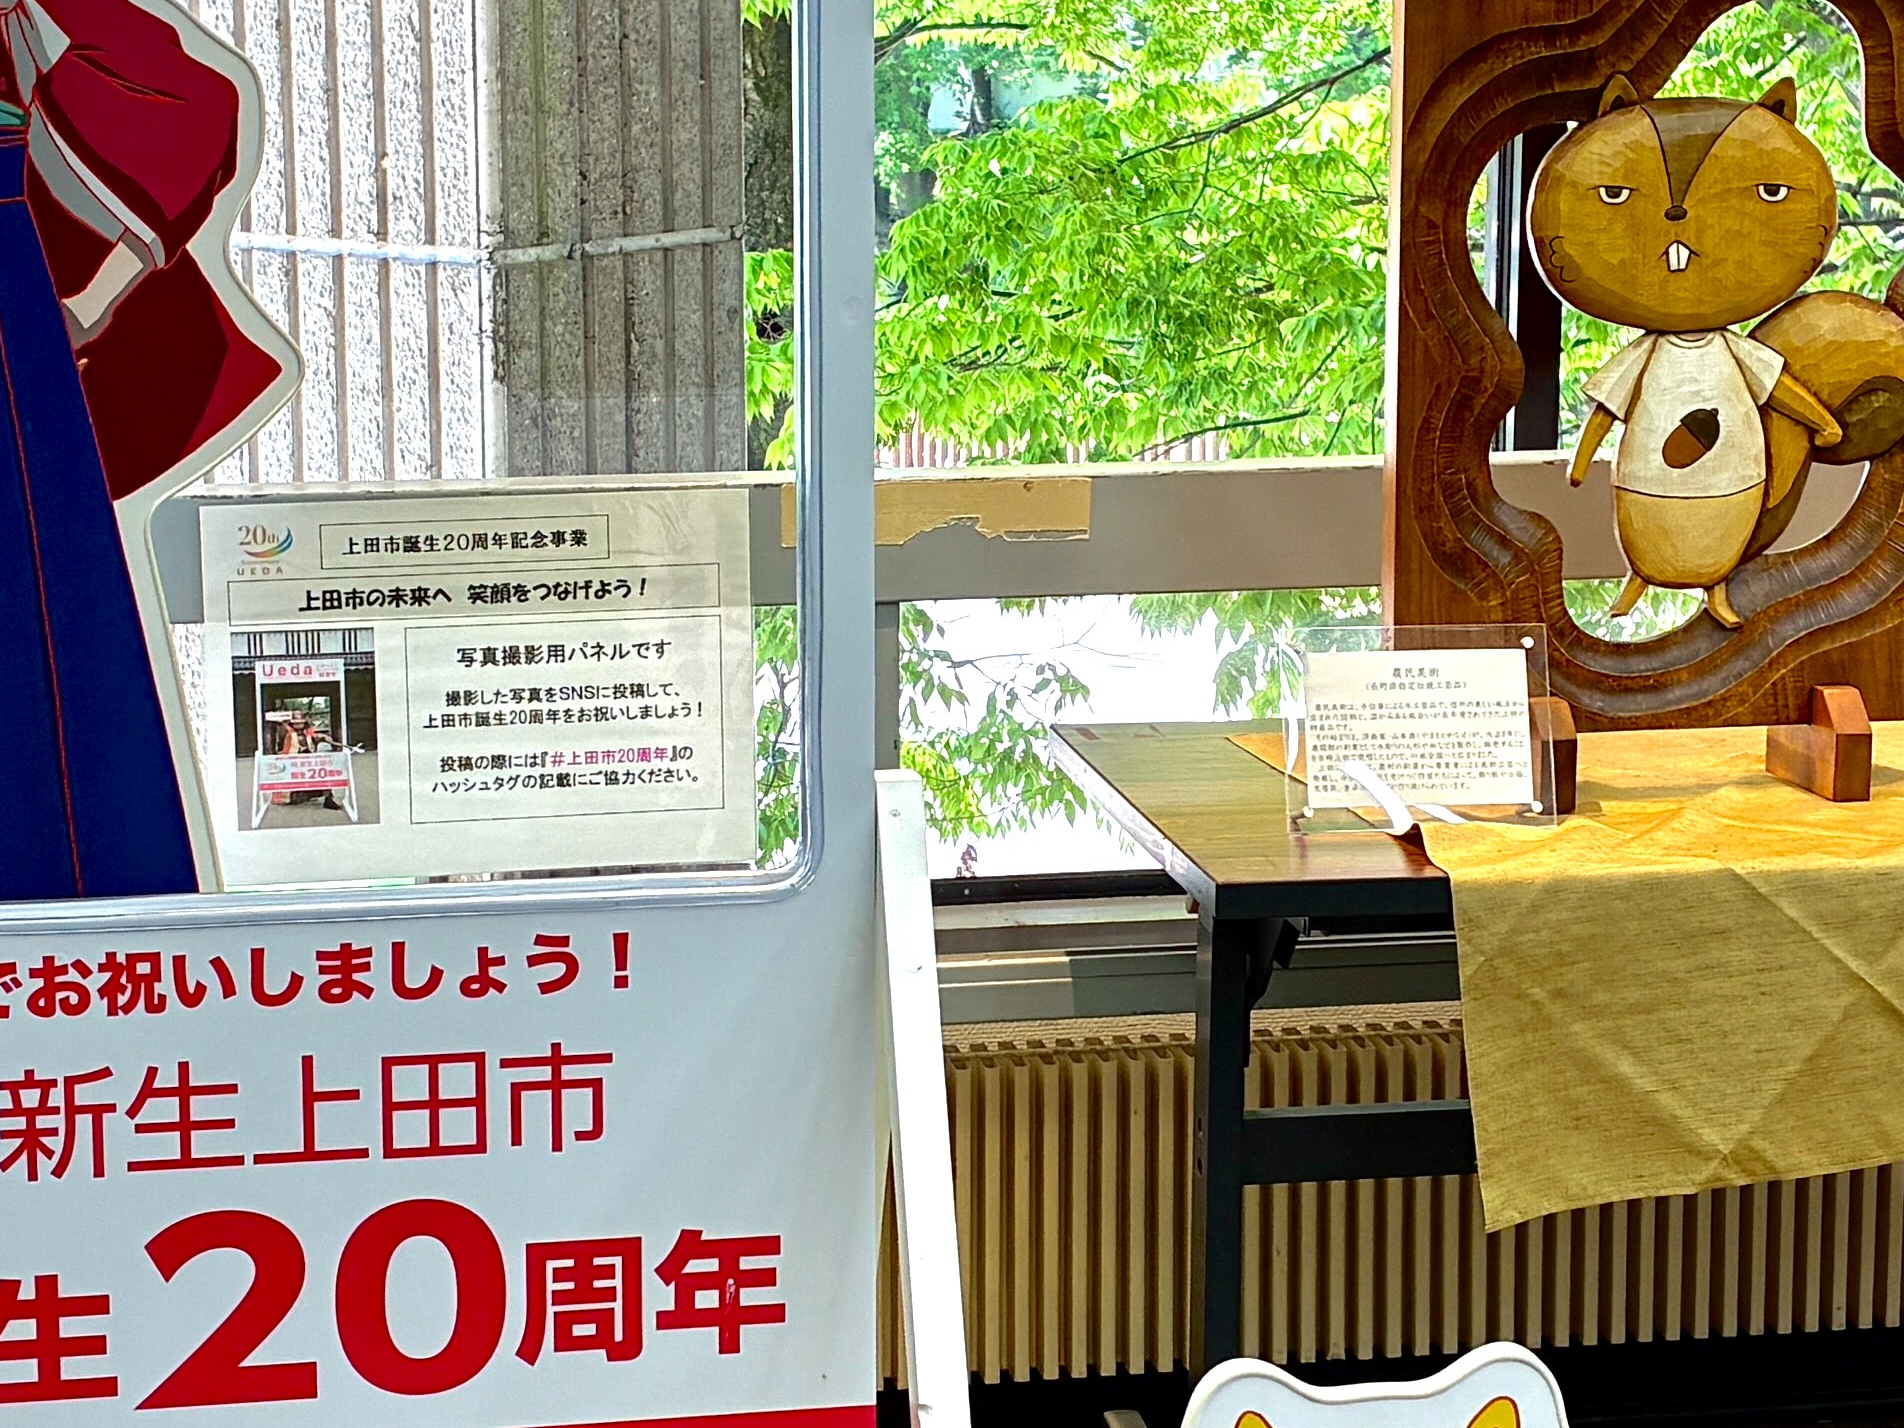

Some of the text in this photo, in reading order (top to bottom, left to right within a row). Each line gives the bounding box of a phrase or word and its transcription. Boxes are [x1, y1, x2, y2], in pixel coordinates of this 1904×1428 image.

[342, 529, 589, 555] 上田市誕生20周年記念事業
[298, 577, 649, 612] 上田市の未来へ 笑顔をつなげよう！
[456, 639, 672, 668] 写真撮影用パネルです
[446, 683, 681, 706] 撮影した写真をSNSに投稿して、
[422, 701, 703, 729] 上田市誕生20周年をお祝いしましょう！
[432, 770, 699, 794] ハッシュタグの記載にご協力ください。
